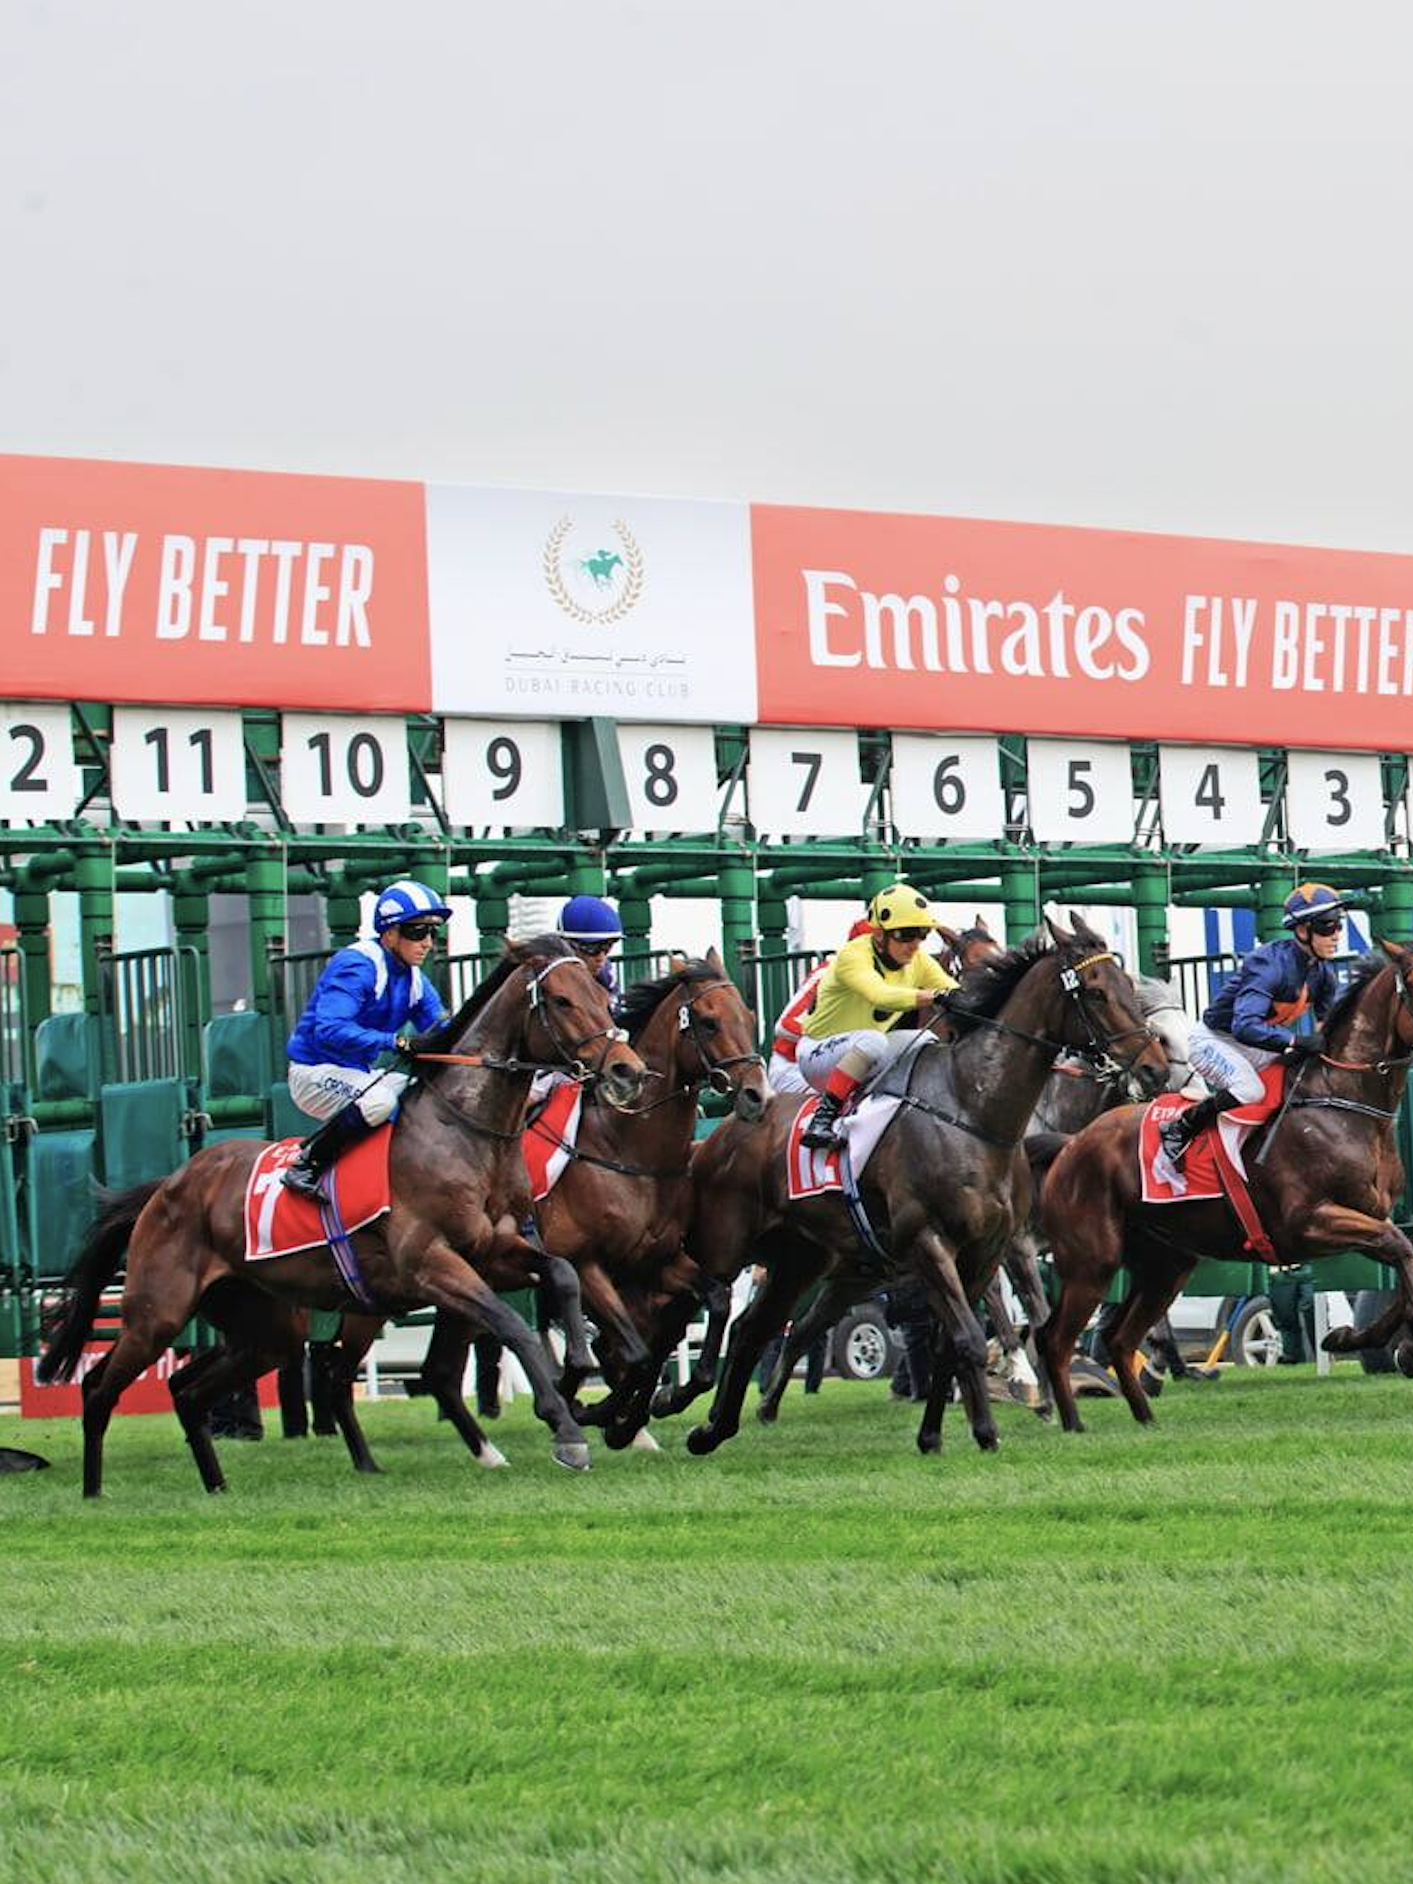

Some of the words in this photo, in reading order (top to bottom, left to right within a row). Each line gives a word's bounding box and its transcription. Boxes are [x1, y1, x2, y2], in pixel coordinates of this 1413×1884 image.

[31, 526, 138, 636] FLY
[155, 533, 375, 650] BETTER
[801, 568, 1151, 682] Emirates
[1181, 594, 1257, 689] FLY
[505, 676, 561, 694] DUBAI
[570, 678, 637, 697] RACING
[645, 680, 690, 699] CLUB
[145, 728, 214, 794] 11
[308, 733, 384, 798] 10
[487, 737, 522, 801] 9
[644, 744, 678, 807] 8
[791, 752, 822, 812] 7
[933, 755, 966, 815] 6
[1068, 760, 1095, 818] 5
[1195, 764, 1225, 820] 4
[1325, 769, 1352, 826] 3
[1060, 968, 1081, 992] 12
[678, 1005, 690, 1032] 8
[253, 1167, 288, 1254] 7
